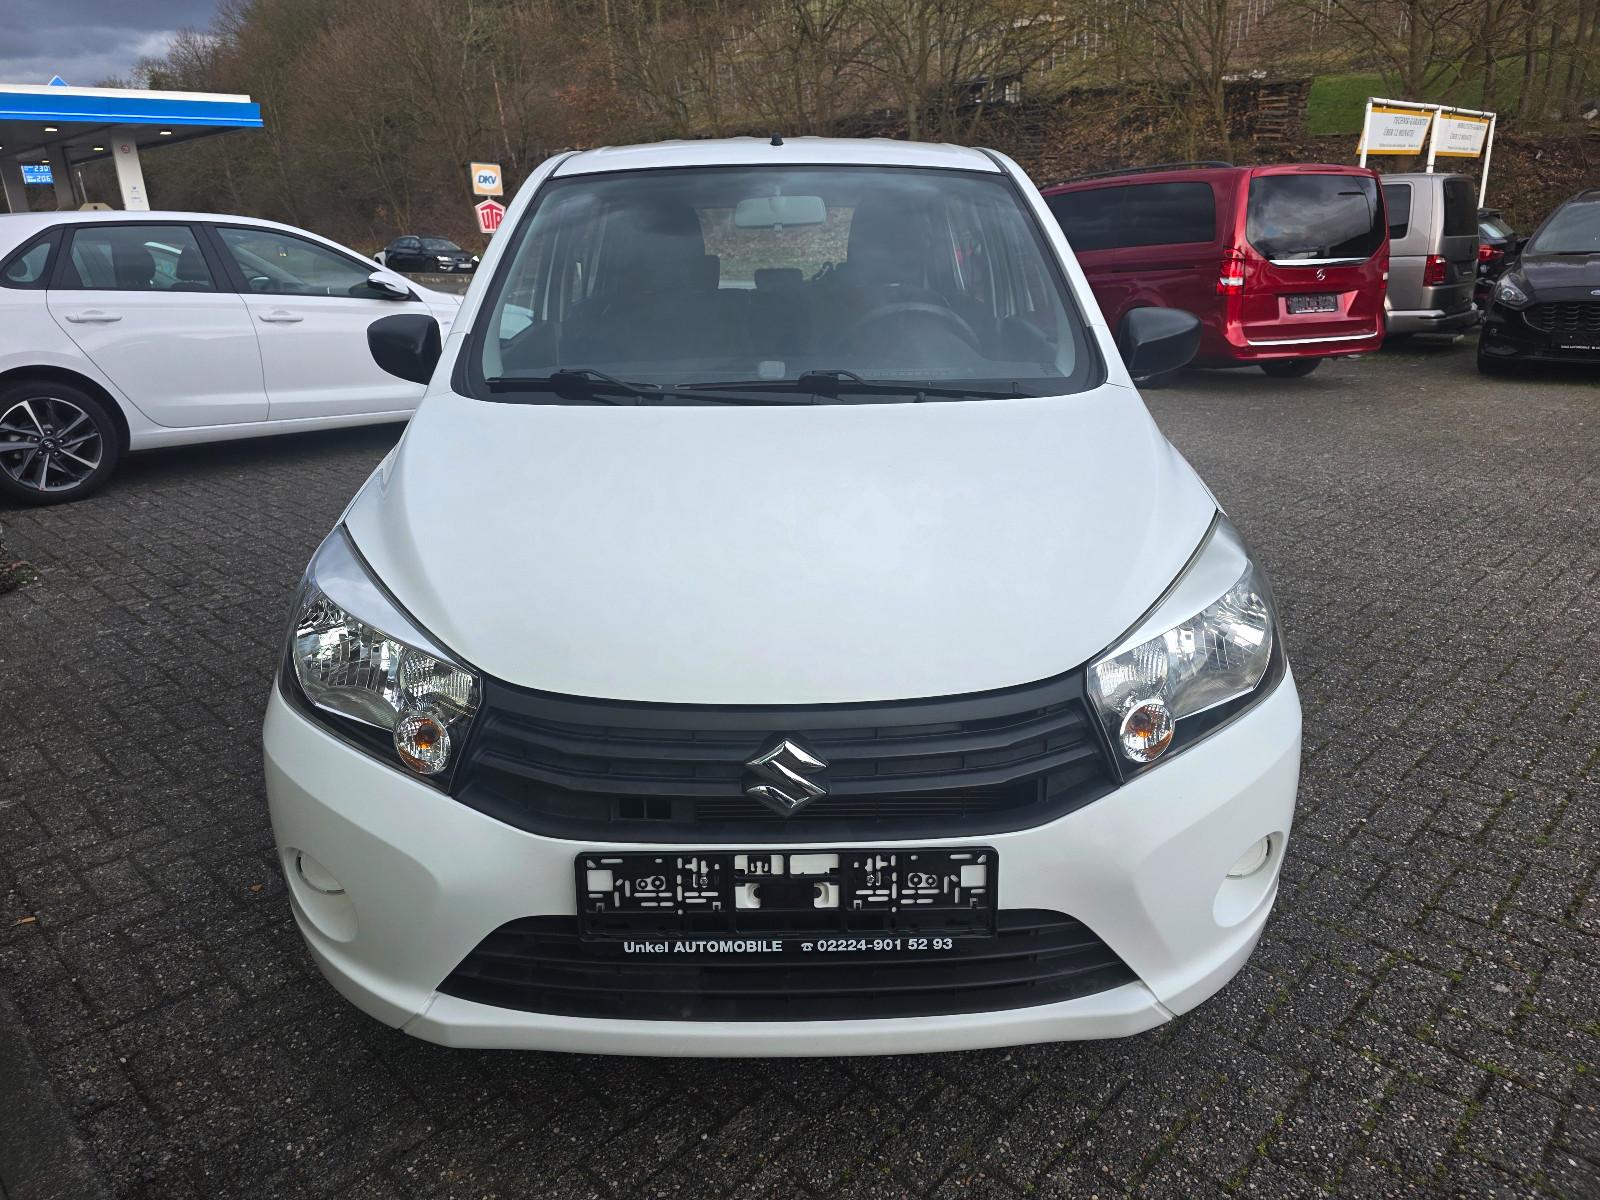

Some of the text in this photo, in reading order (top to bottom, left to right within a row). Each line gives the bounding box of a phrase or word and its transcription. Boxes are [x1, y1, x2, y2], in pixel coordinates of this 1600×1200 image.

[478, 175, 497, 184] DKV
[623, 938, 953, 953] Unkel AUTOMOBILE 02224-901 52 93
